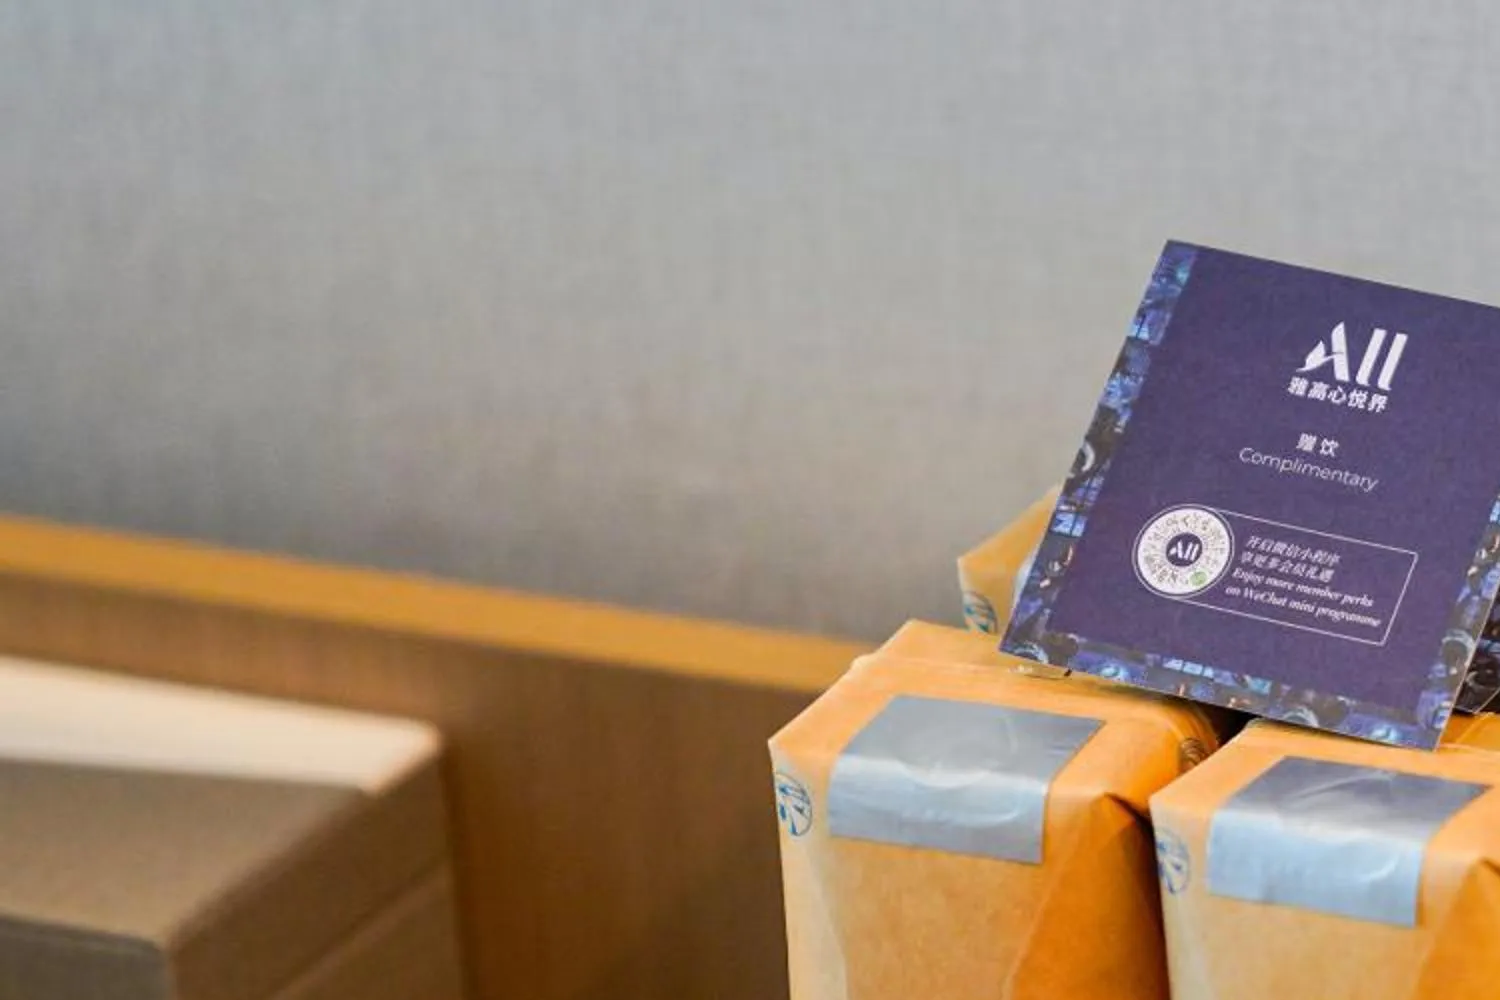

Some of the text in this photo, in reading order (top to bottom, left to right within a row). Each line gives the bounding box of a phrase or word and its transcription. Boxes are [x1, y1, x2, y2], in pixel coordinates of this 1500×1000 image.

[1287, 376, 1389, 413] 雅高心悦界
[1238, 446, 1380, 493] Complimentary
[1225, 585, 1382, 628] on WeChat mini programme
[1232, 567, 1374, 608] Enjoy more member perks
